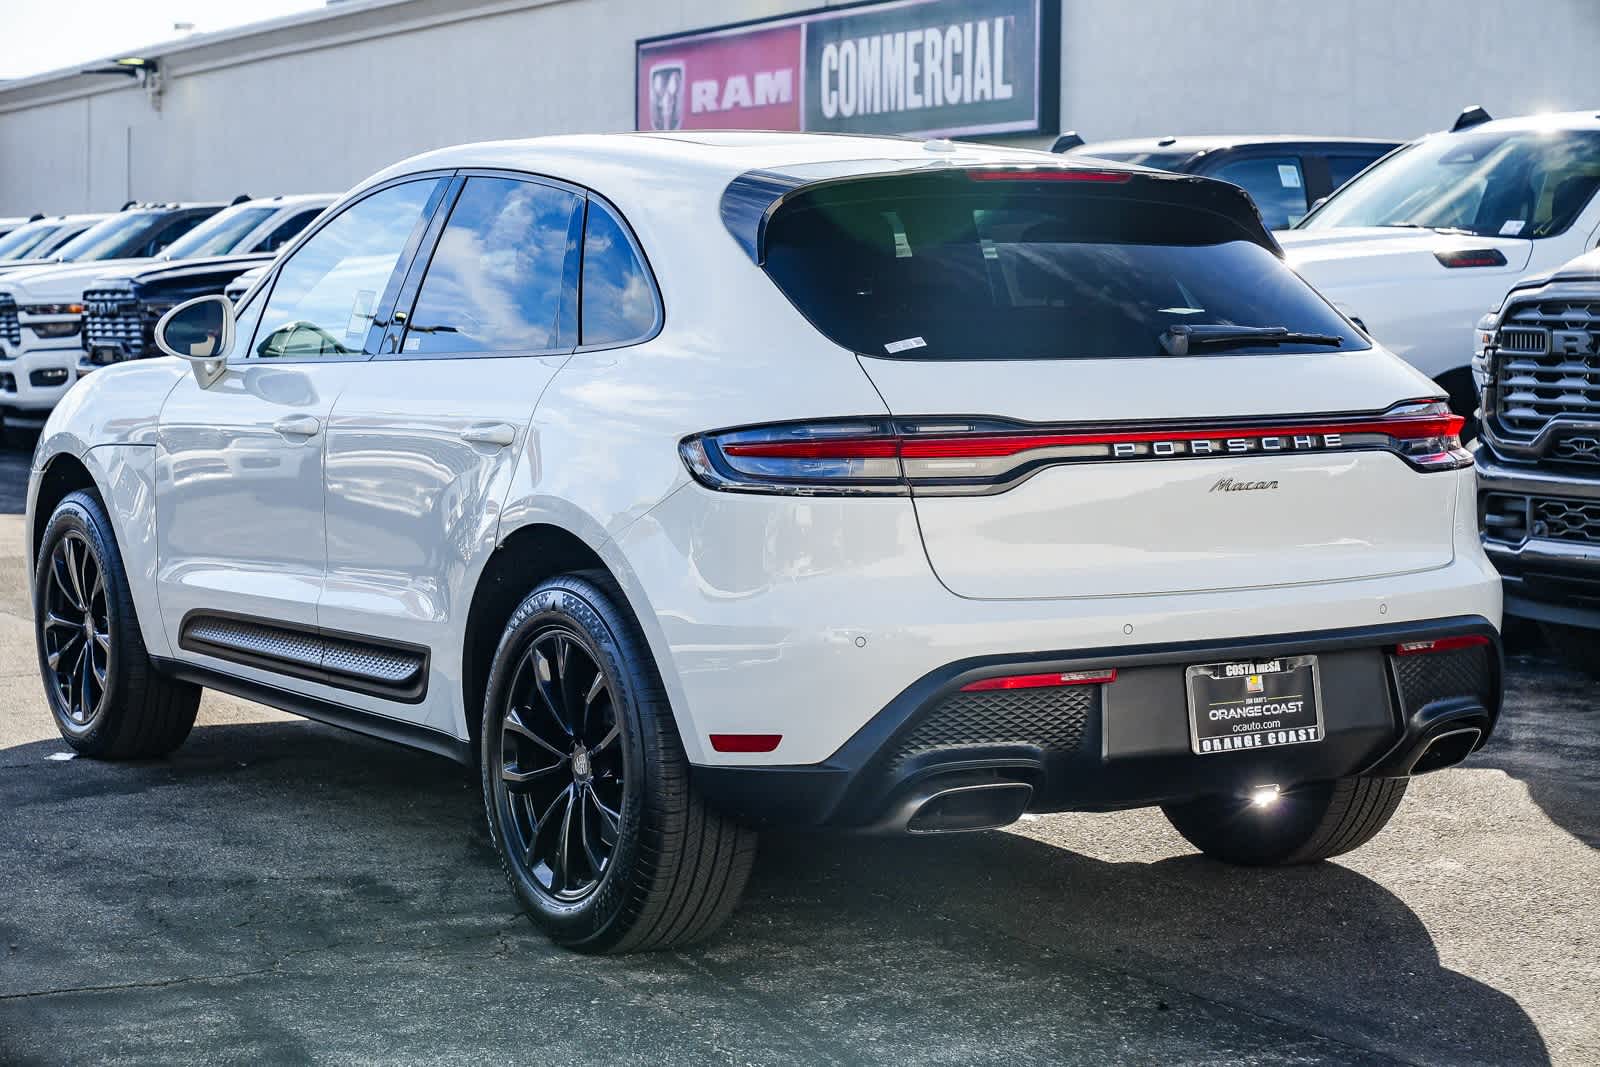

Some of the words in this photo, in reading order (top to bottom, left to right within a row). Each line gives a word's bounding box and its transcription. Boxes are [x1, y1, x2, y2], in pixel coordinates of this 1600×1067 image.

[820, 16, 1013, 119] COMMERCIAL
[691, 68, 793, 114] RAM
[1113, 433, 1343, 457] PORSCHE
[1208, 477, 1279, 493] Macan
[1225, 663, 1256, 676] COSTA
[1256, 660, 1281, 674] MESA
[1232, 719, 1281, 733] ocauto.com
[1202, 733, 1262, 752] ORANGE
[1267, 728, 1316, 745] COAST
